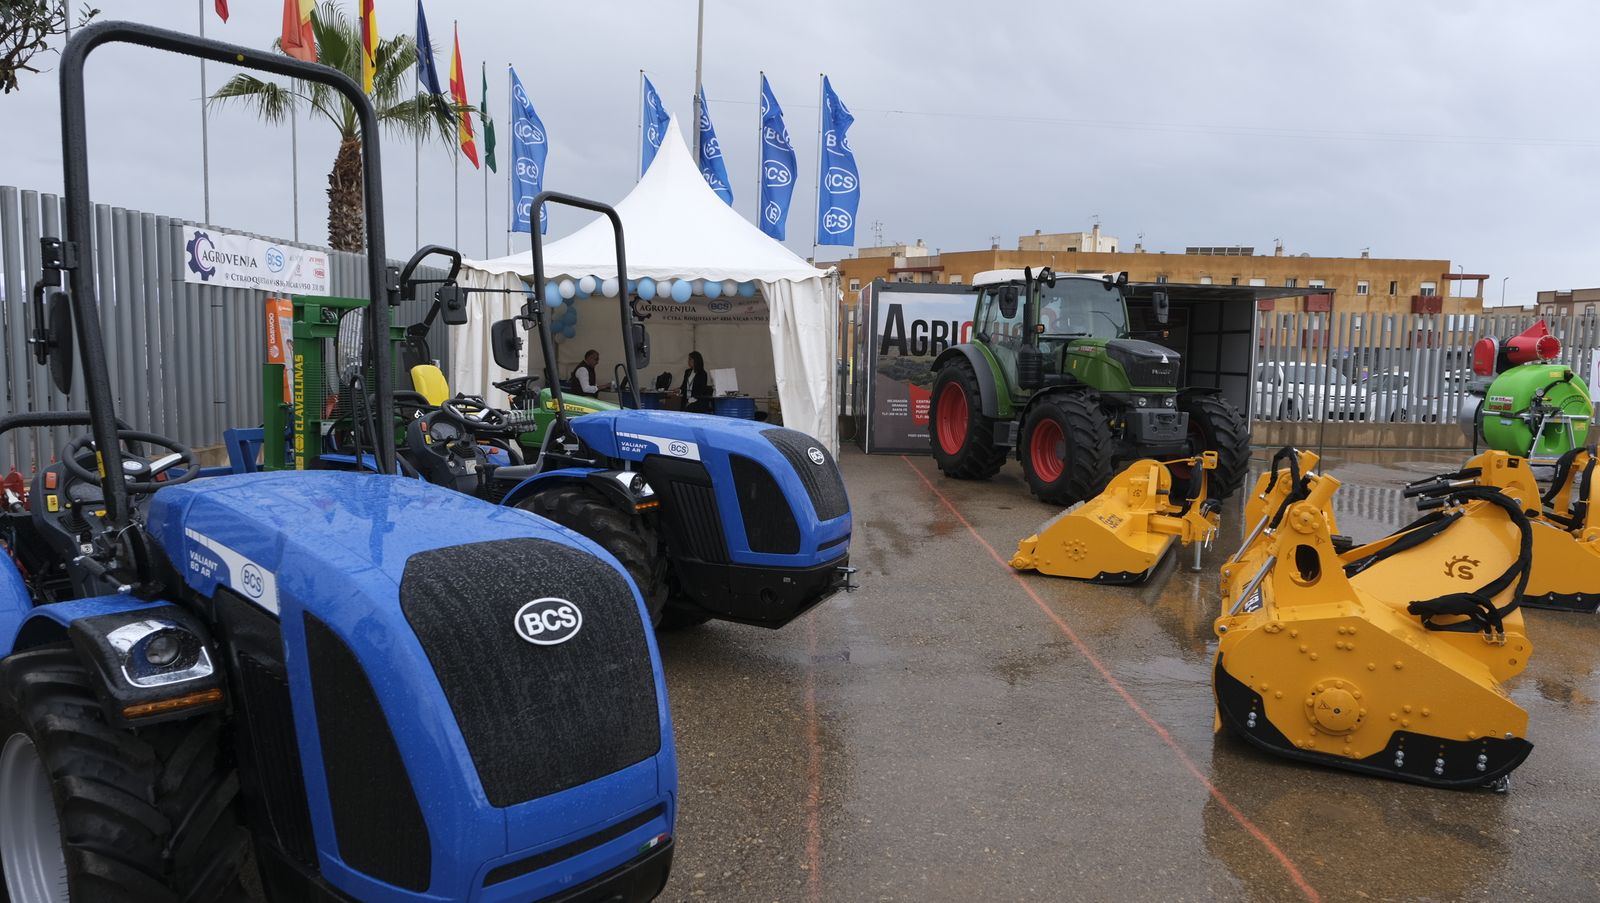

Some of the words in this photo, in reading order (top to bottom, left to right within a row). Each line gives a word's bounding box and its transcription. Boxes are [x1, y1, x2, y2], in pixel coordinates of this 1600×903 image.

[639, 304, 697, 314] AGROVENJUA
[710, 302, 729, 311] BCS
[268, 312, 276, 345] DAEWOO
[294, 354, 304, 431] CLAVELLINAS
[621, 441, 648, 449] VALIANT
[670, 443, 687, 454] BCS
[190, 550, 219, 572] VALIANT
[243, 569, 262, 593] BCS
[201, 566, 212, 578] AR
[522, 605, 577, 637] BCS
